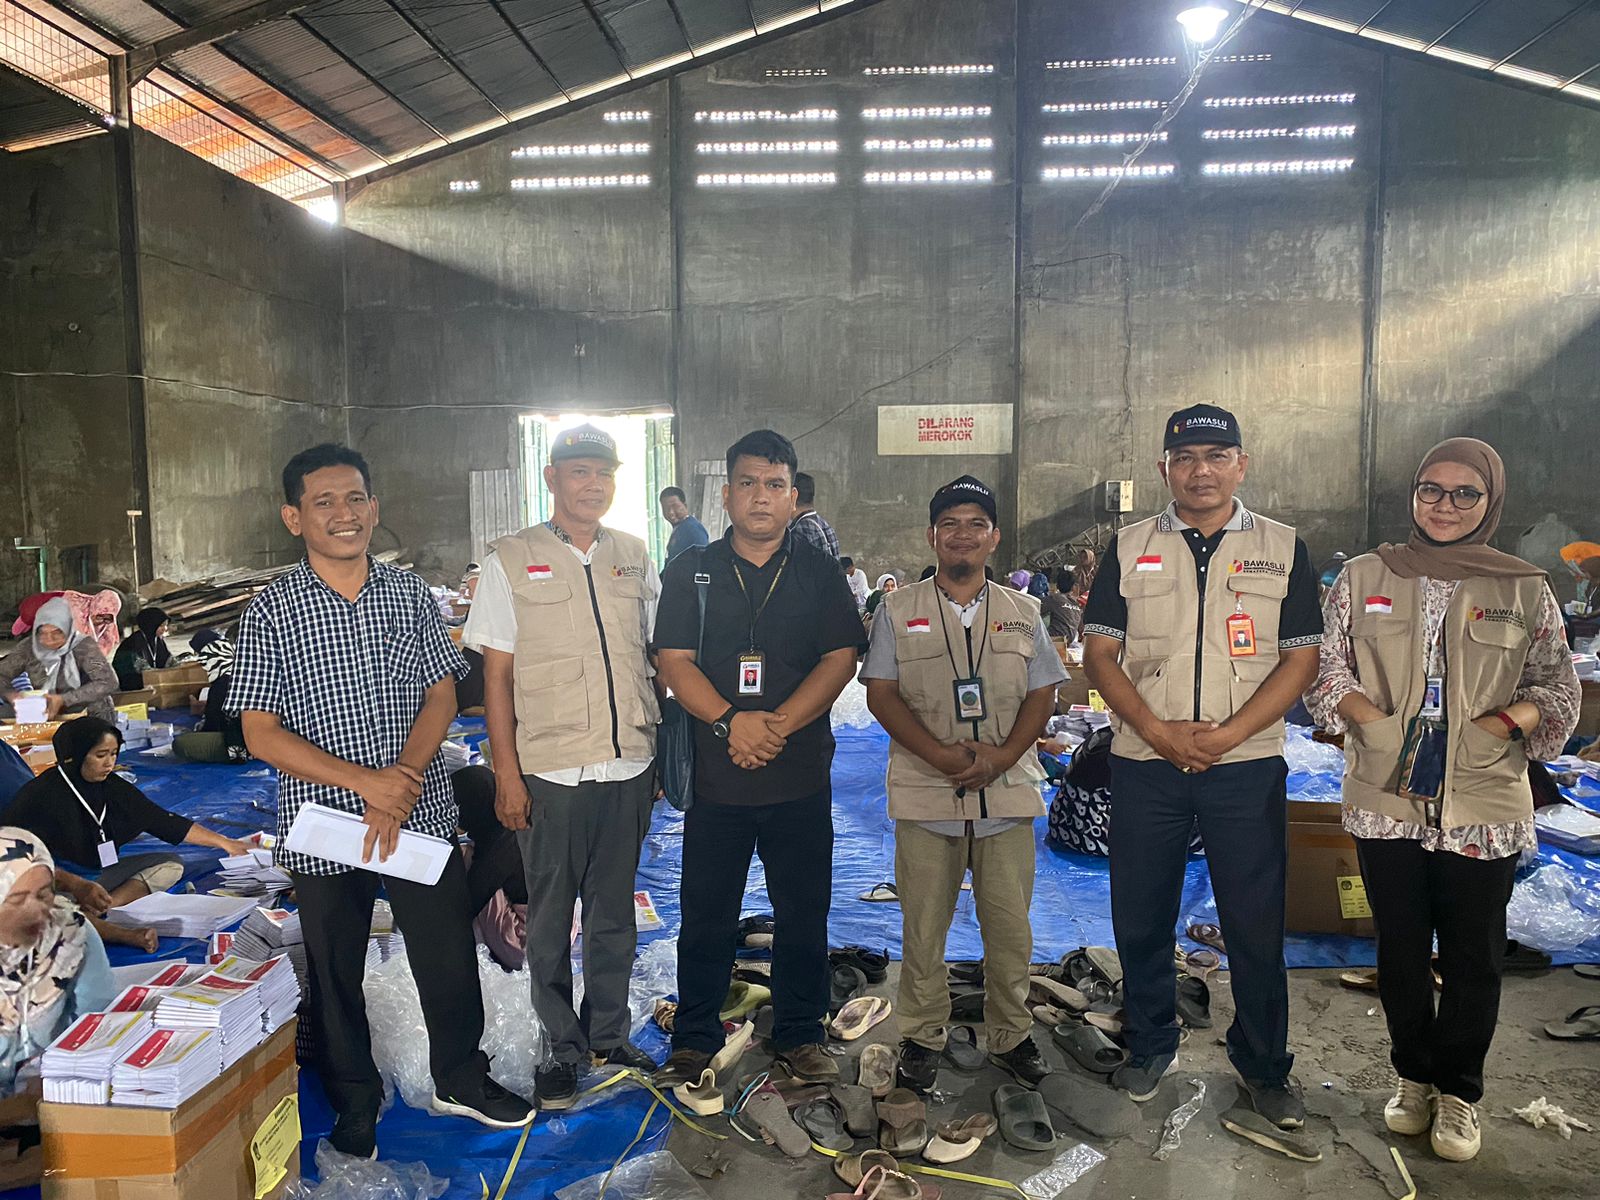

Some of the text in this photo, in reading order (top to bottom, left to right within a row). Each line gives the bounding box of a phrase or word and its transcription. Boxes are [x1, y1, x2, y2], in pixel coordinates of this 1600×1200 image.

[918, 417, 974, 429] DILARANG
[1186, 417, 1228, 427] BAWASLU
[918, 430, 972, 441] MEROKOK
[952, 483, 989, 496] BAWASLU
[1243, 560, 1285, 570] BAWASLU
